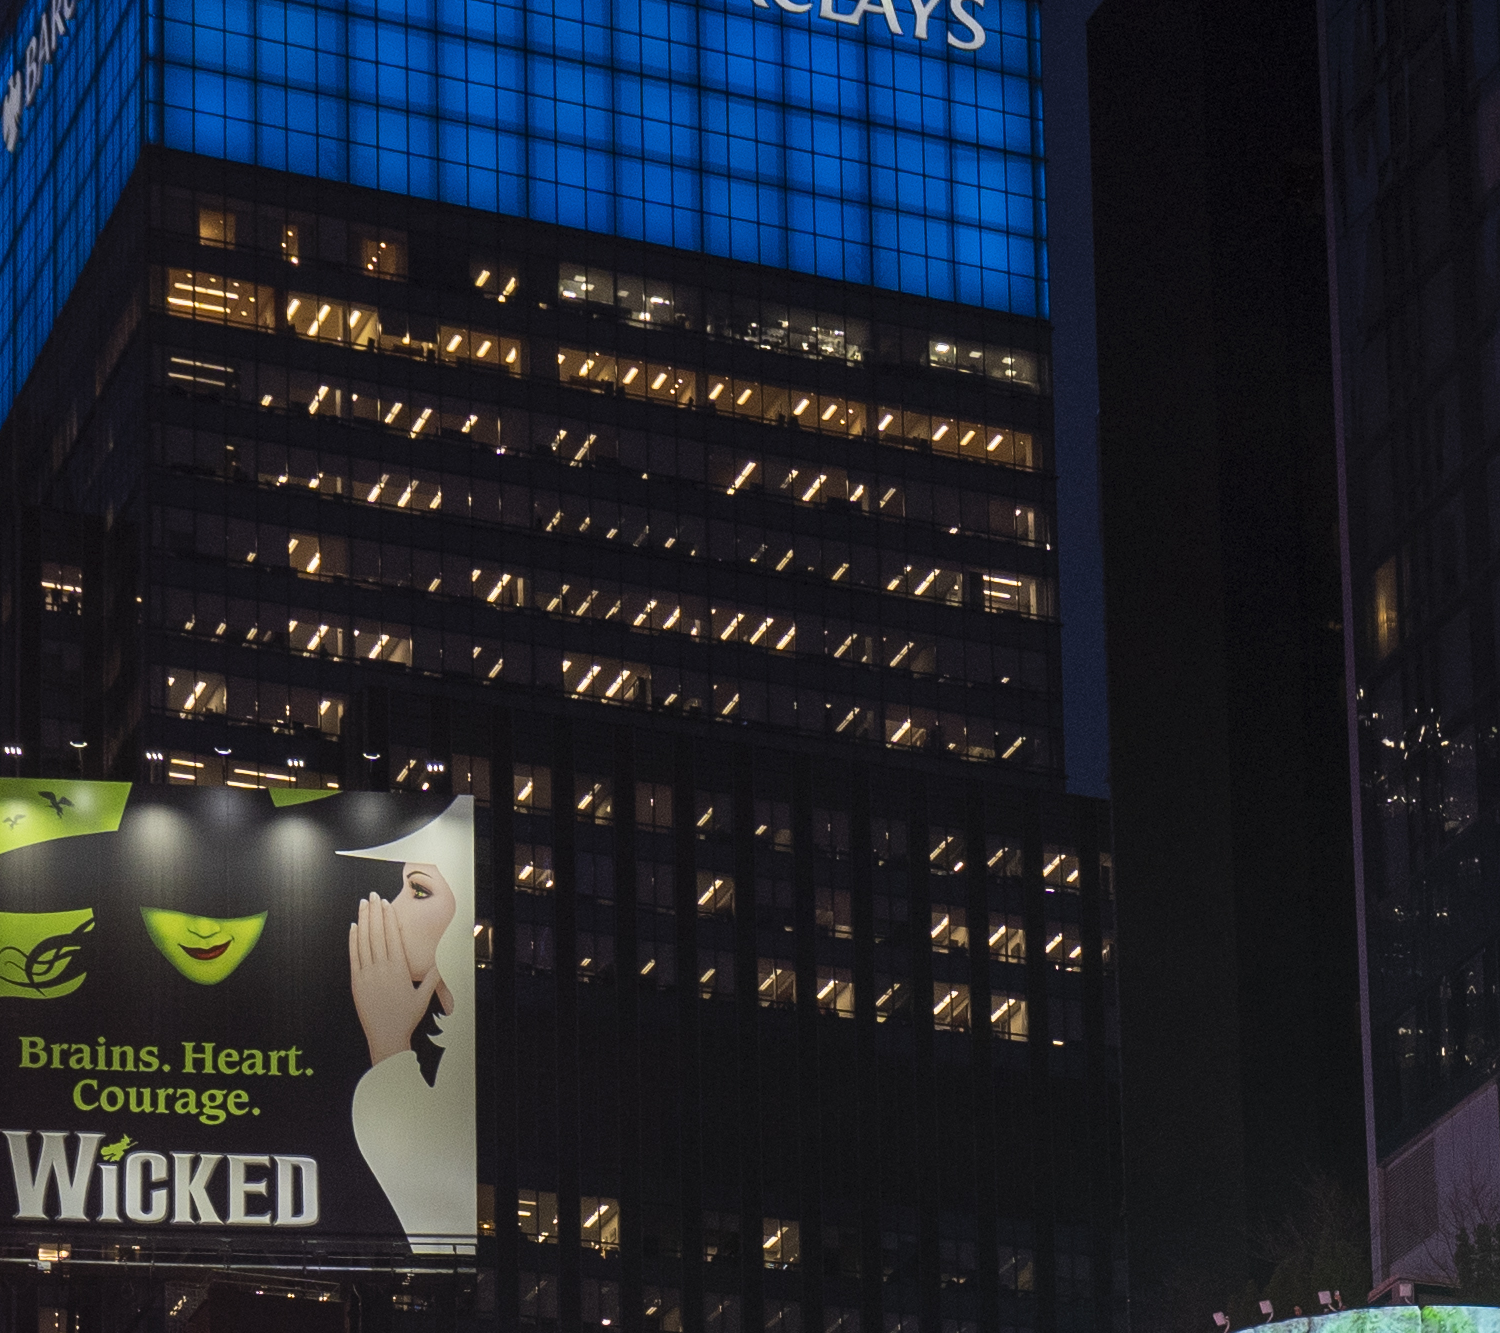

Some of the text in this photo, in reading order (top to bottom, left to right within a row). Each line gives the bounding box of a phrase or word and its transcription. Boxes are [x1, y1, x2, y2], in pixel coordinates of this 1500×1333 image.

[19, 1036, 315, 1077] Brains. Heart.
[73, 1080, 261, 1125] Courage.
